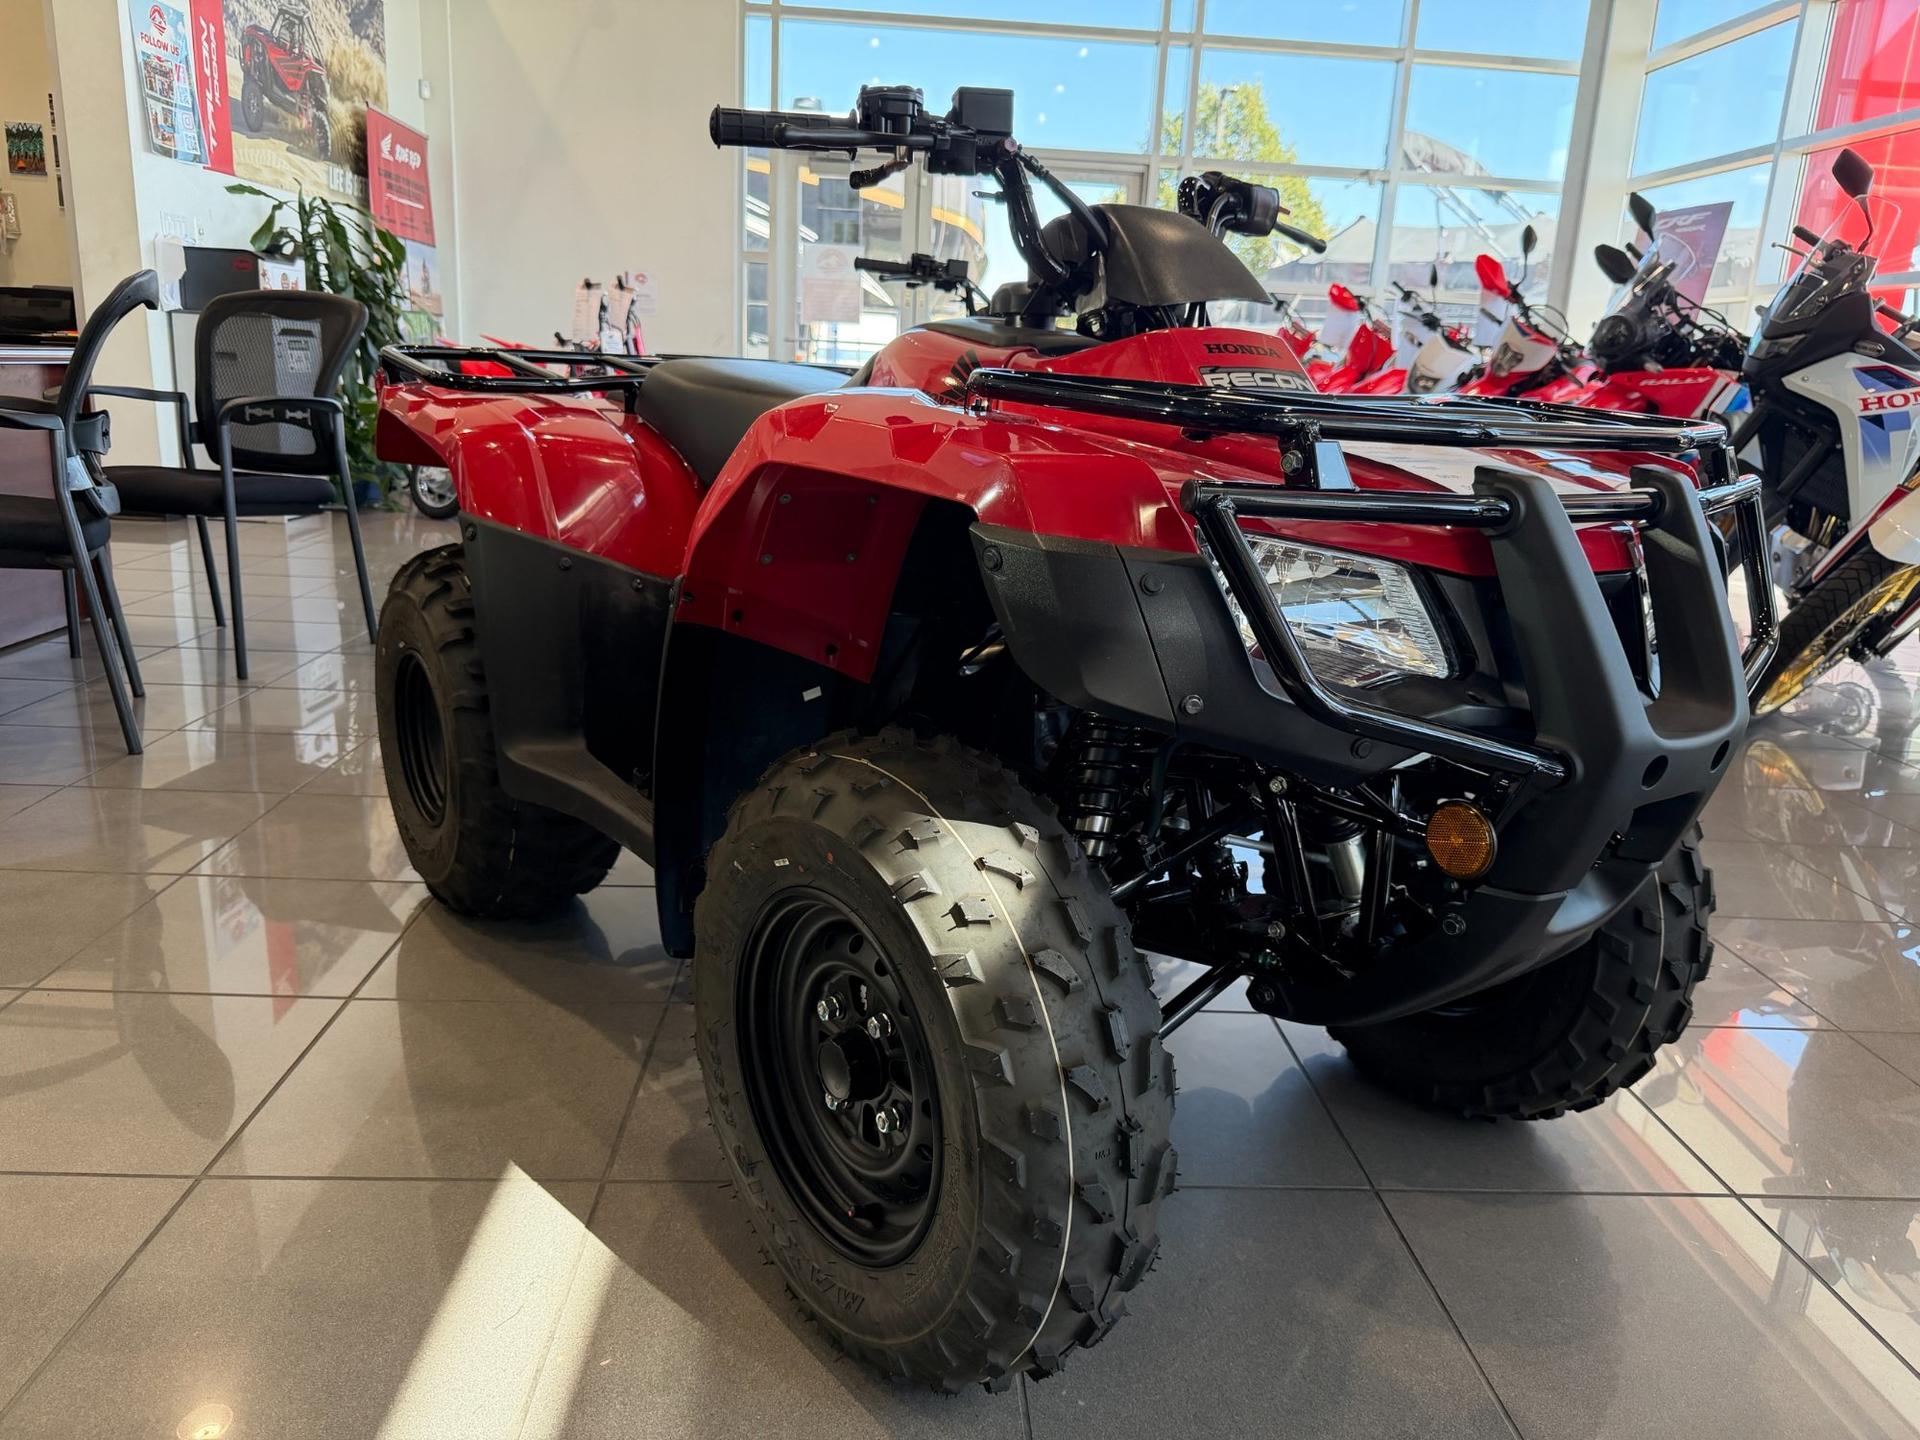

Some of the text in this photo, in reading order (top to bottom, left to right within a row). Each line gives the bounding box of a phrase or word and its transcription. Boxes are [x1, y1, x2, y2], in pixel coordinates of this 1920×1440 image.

[140, 31, 180, 57] FOLLOW US
[1204, 343, 1281, 358] HONDA
[1202, 372, 1316, 394] RECON
[1639, 376, 1712, 387] RALLY
